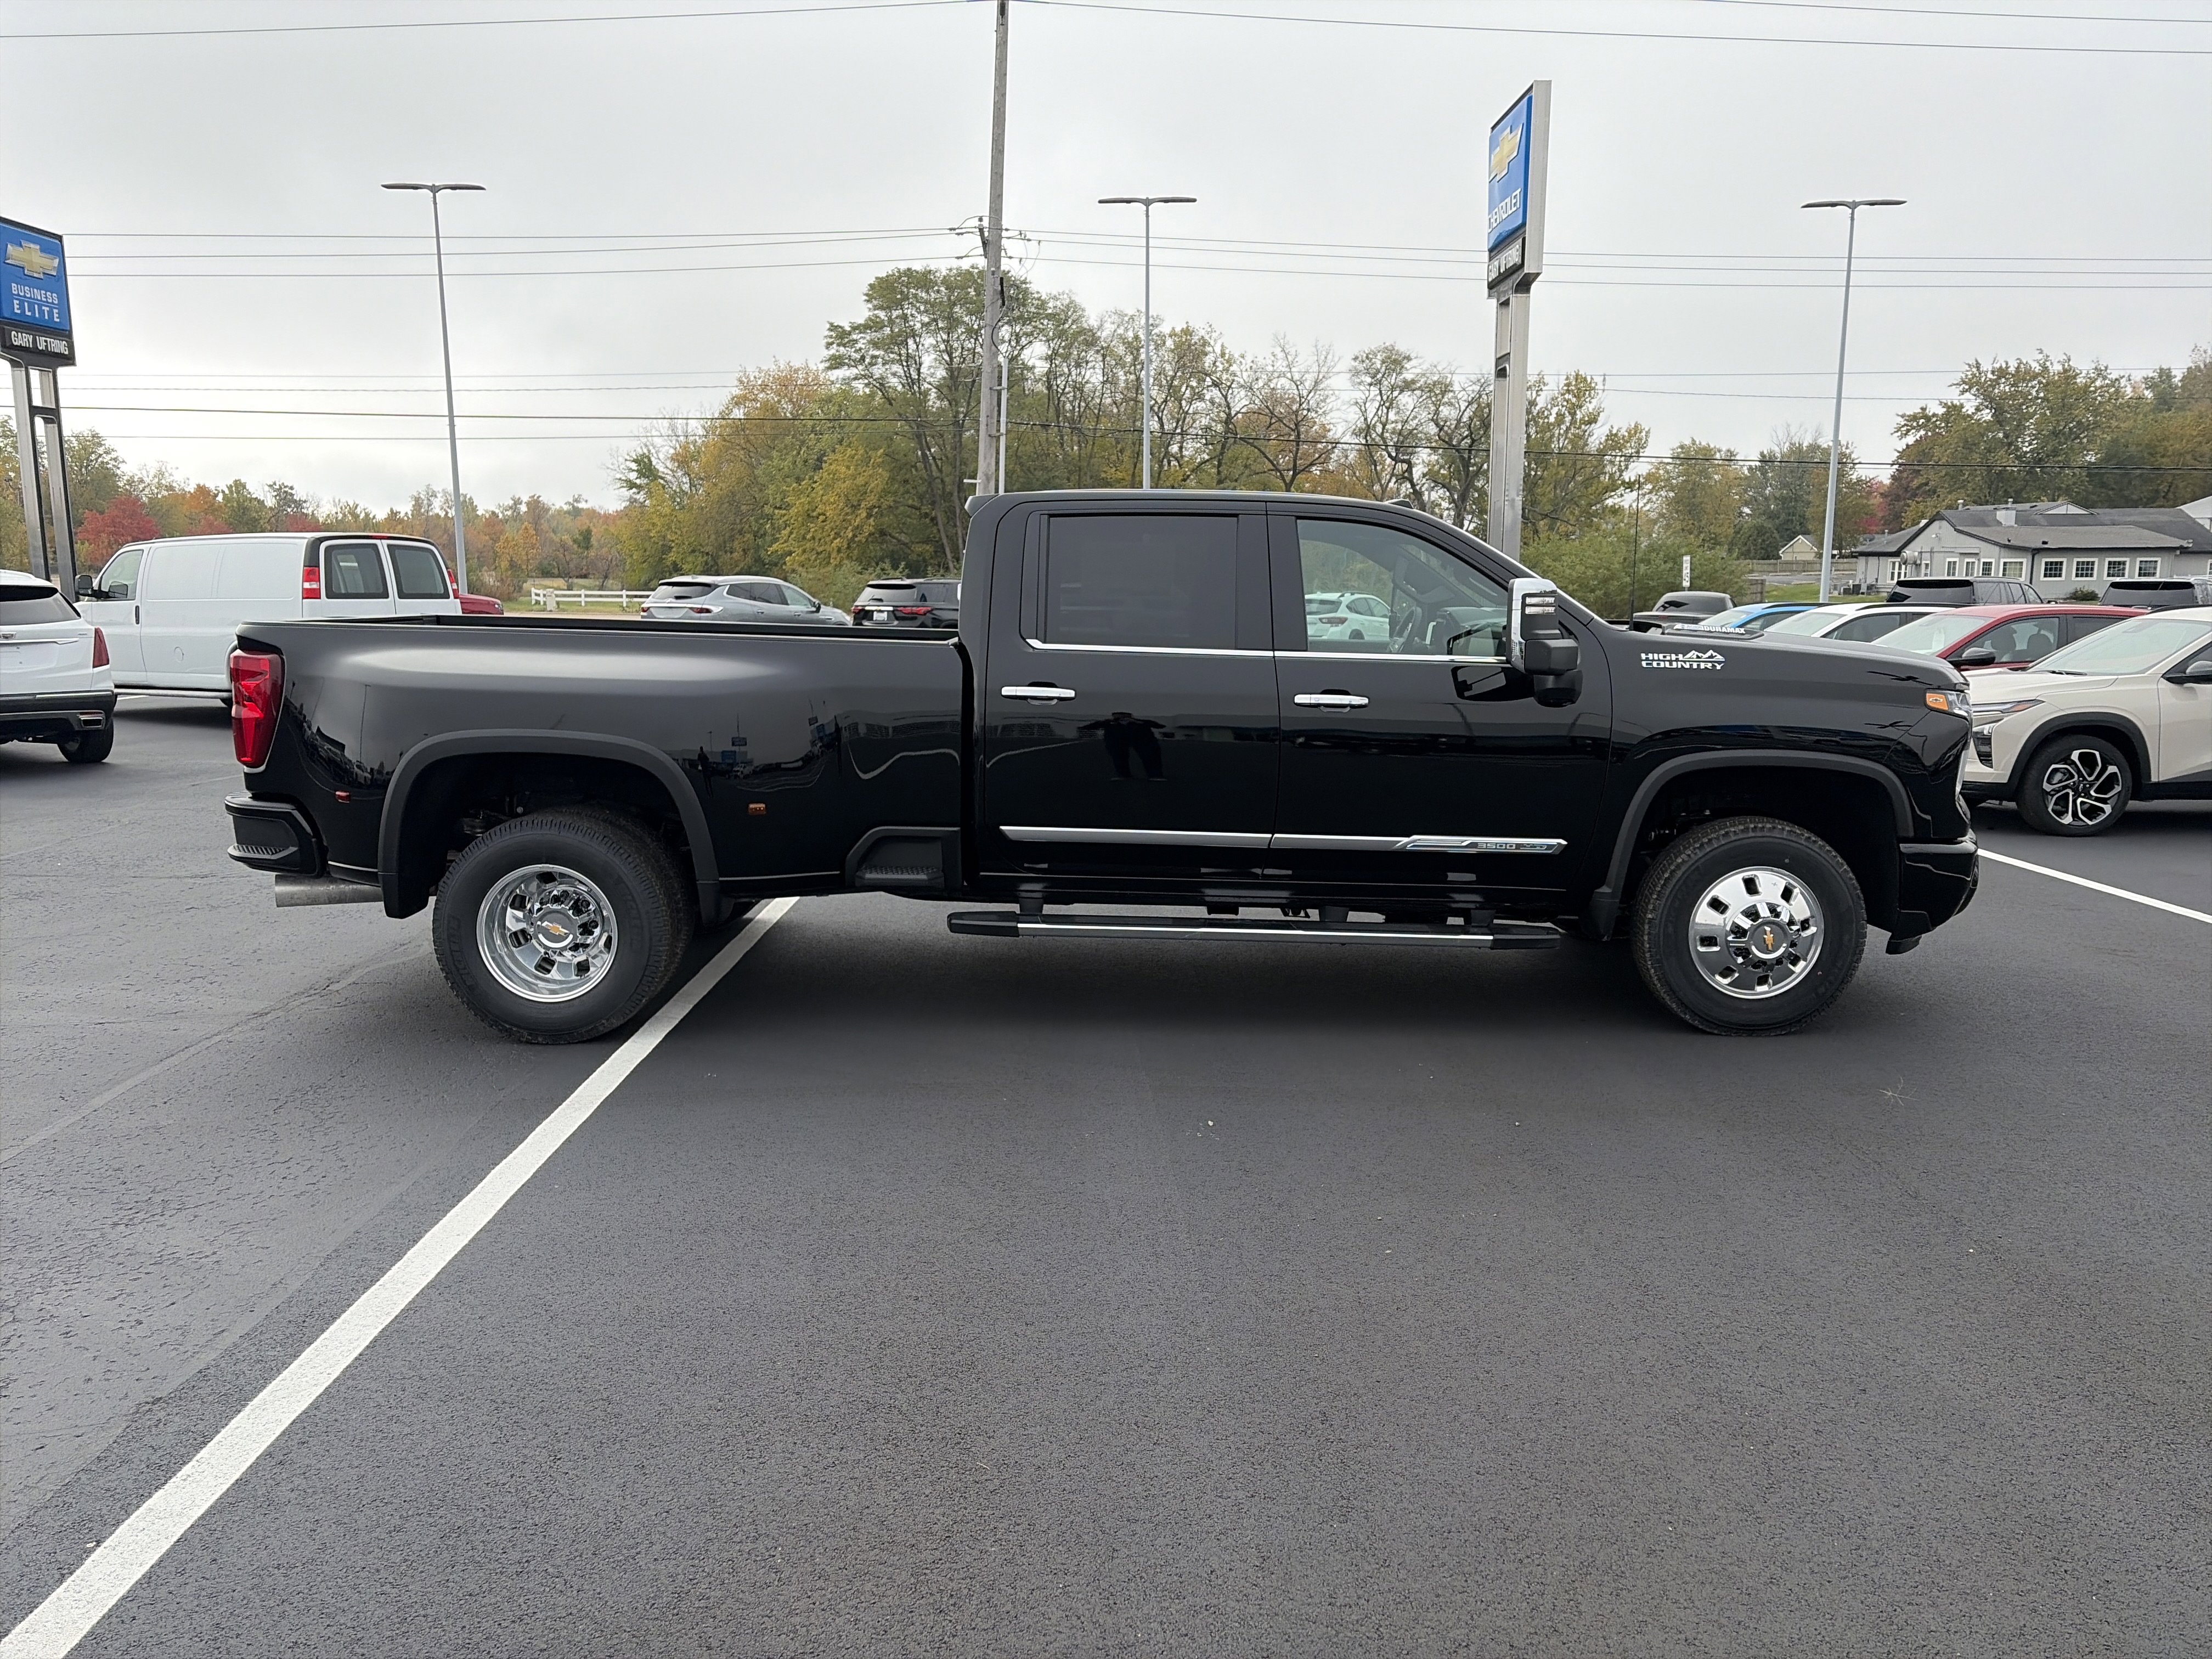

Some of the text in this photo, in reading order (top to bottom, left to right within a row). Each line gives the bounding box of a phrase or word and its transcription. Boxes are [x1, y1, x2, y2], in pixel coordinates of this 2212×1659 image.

[1488, 188, 1521, 233] CHEVROLET
[12, 283, 58, 304] BUSINESS
[13, 300, 60, 322] ELITE
[11, 331, 69, 355] GARY UFTRING
[1703, 625, 1746, 634] DURAMAX
[1641, 661, 1725, 670] COUNTRY
